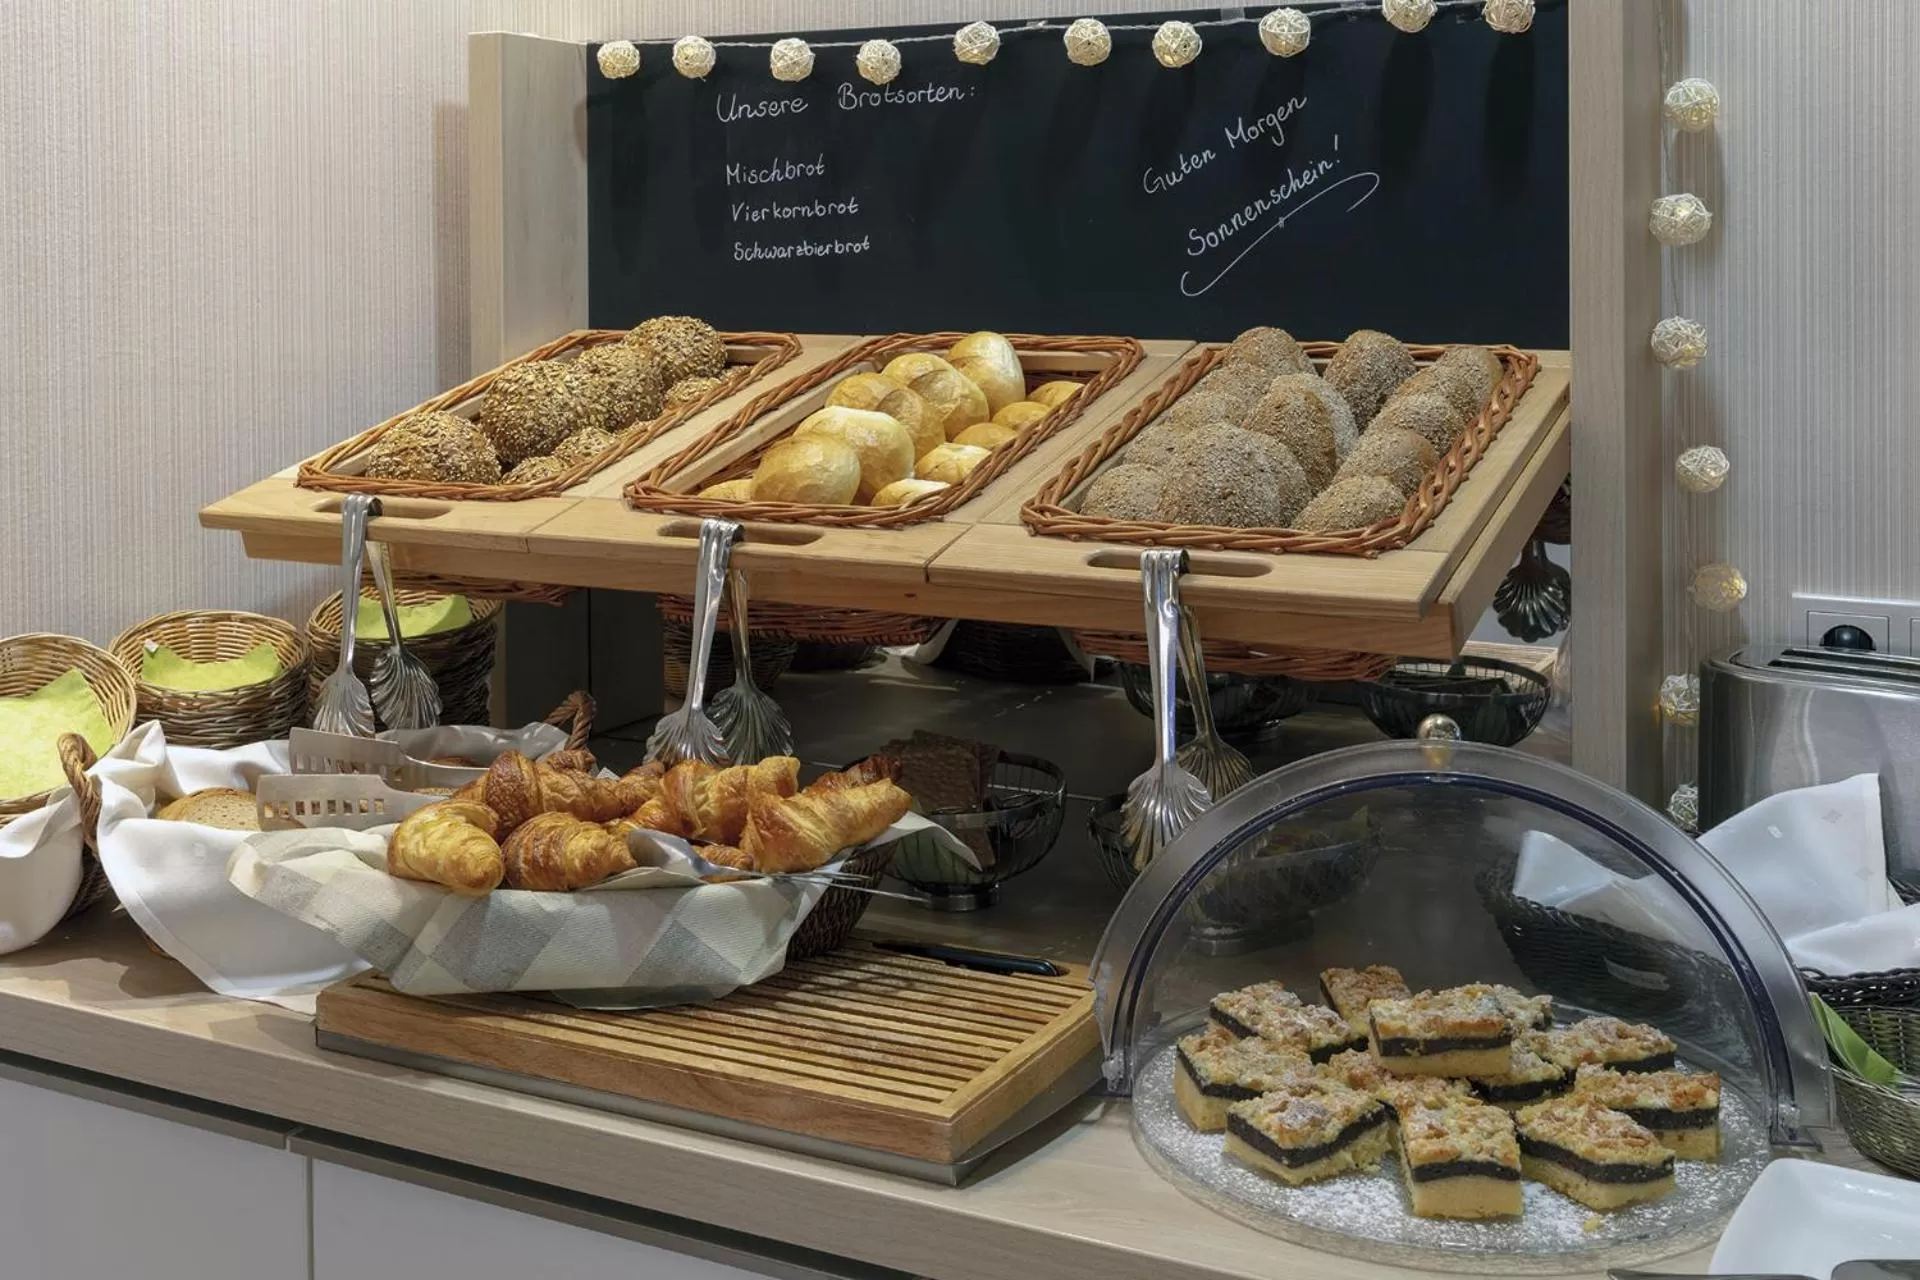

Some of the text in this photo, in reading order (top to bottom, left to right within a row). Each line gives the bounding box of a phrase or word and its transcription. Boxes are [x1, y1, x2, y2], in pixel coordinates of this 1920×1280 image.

[716, 82, 975, 123] Unsere Brotsorten:
[1143, 96, 1308, 194] Guten Morgen
[726, 153, 825, 186] Mischbrot
[731, 197, 859, 222] Vierkornbrot
[1187, 134, 1341, 256] Sonnenschein!
[733, 235, 870, 262] Schwarzbierbrot
